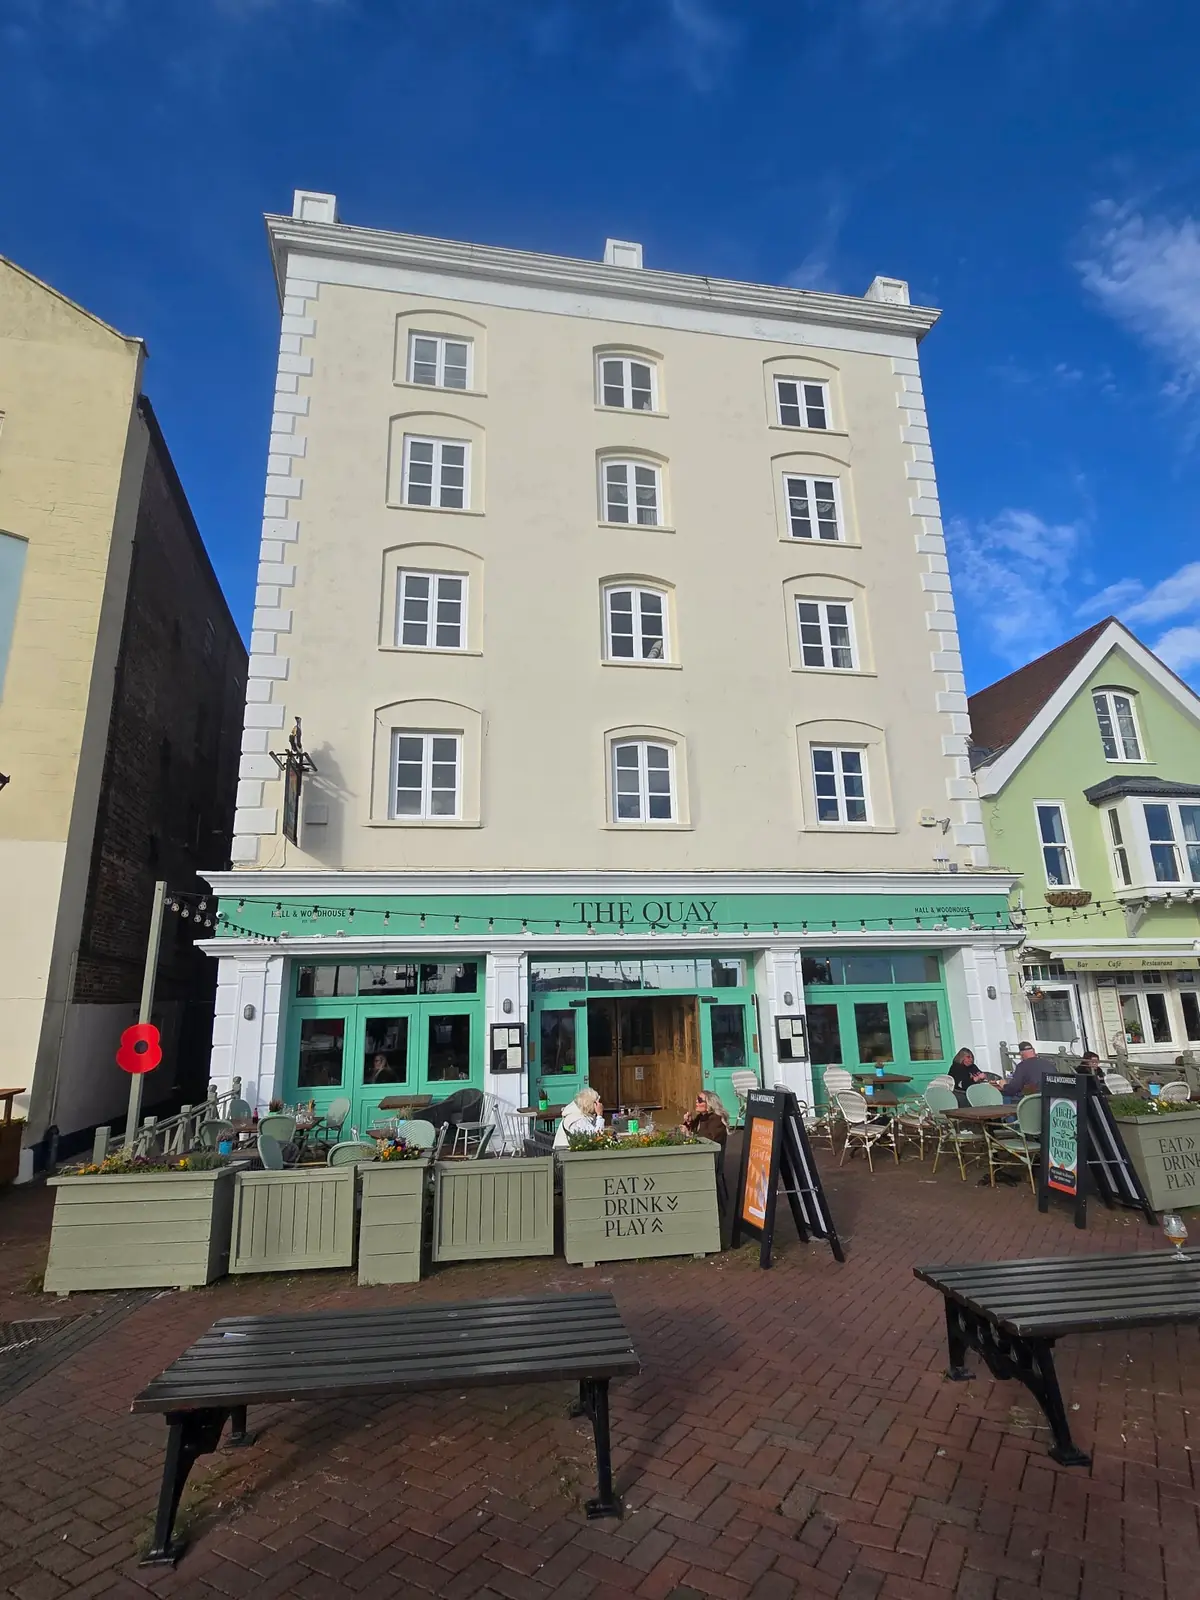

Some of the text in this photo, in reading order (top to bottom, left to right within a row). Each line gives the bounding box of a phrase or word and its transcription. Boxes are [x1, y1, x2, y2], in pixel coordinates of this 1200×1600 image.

[271, 910, 290, 918] HLL
[300, 909, 346, 917] WODHOUSE
[573, 901, 718, 929] THE QUAY
[1159, 1137, 1183, 1153] EAT
[603, 1176, 639, 1196] EAT
[1166, 1172, 1196, 1189] PLAY
[603, 1195, 664, 1217] DRINK
[605, 1217, 648, 1238] PLAY
